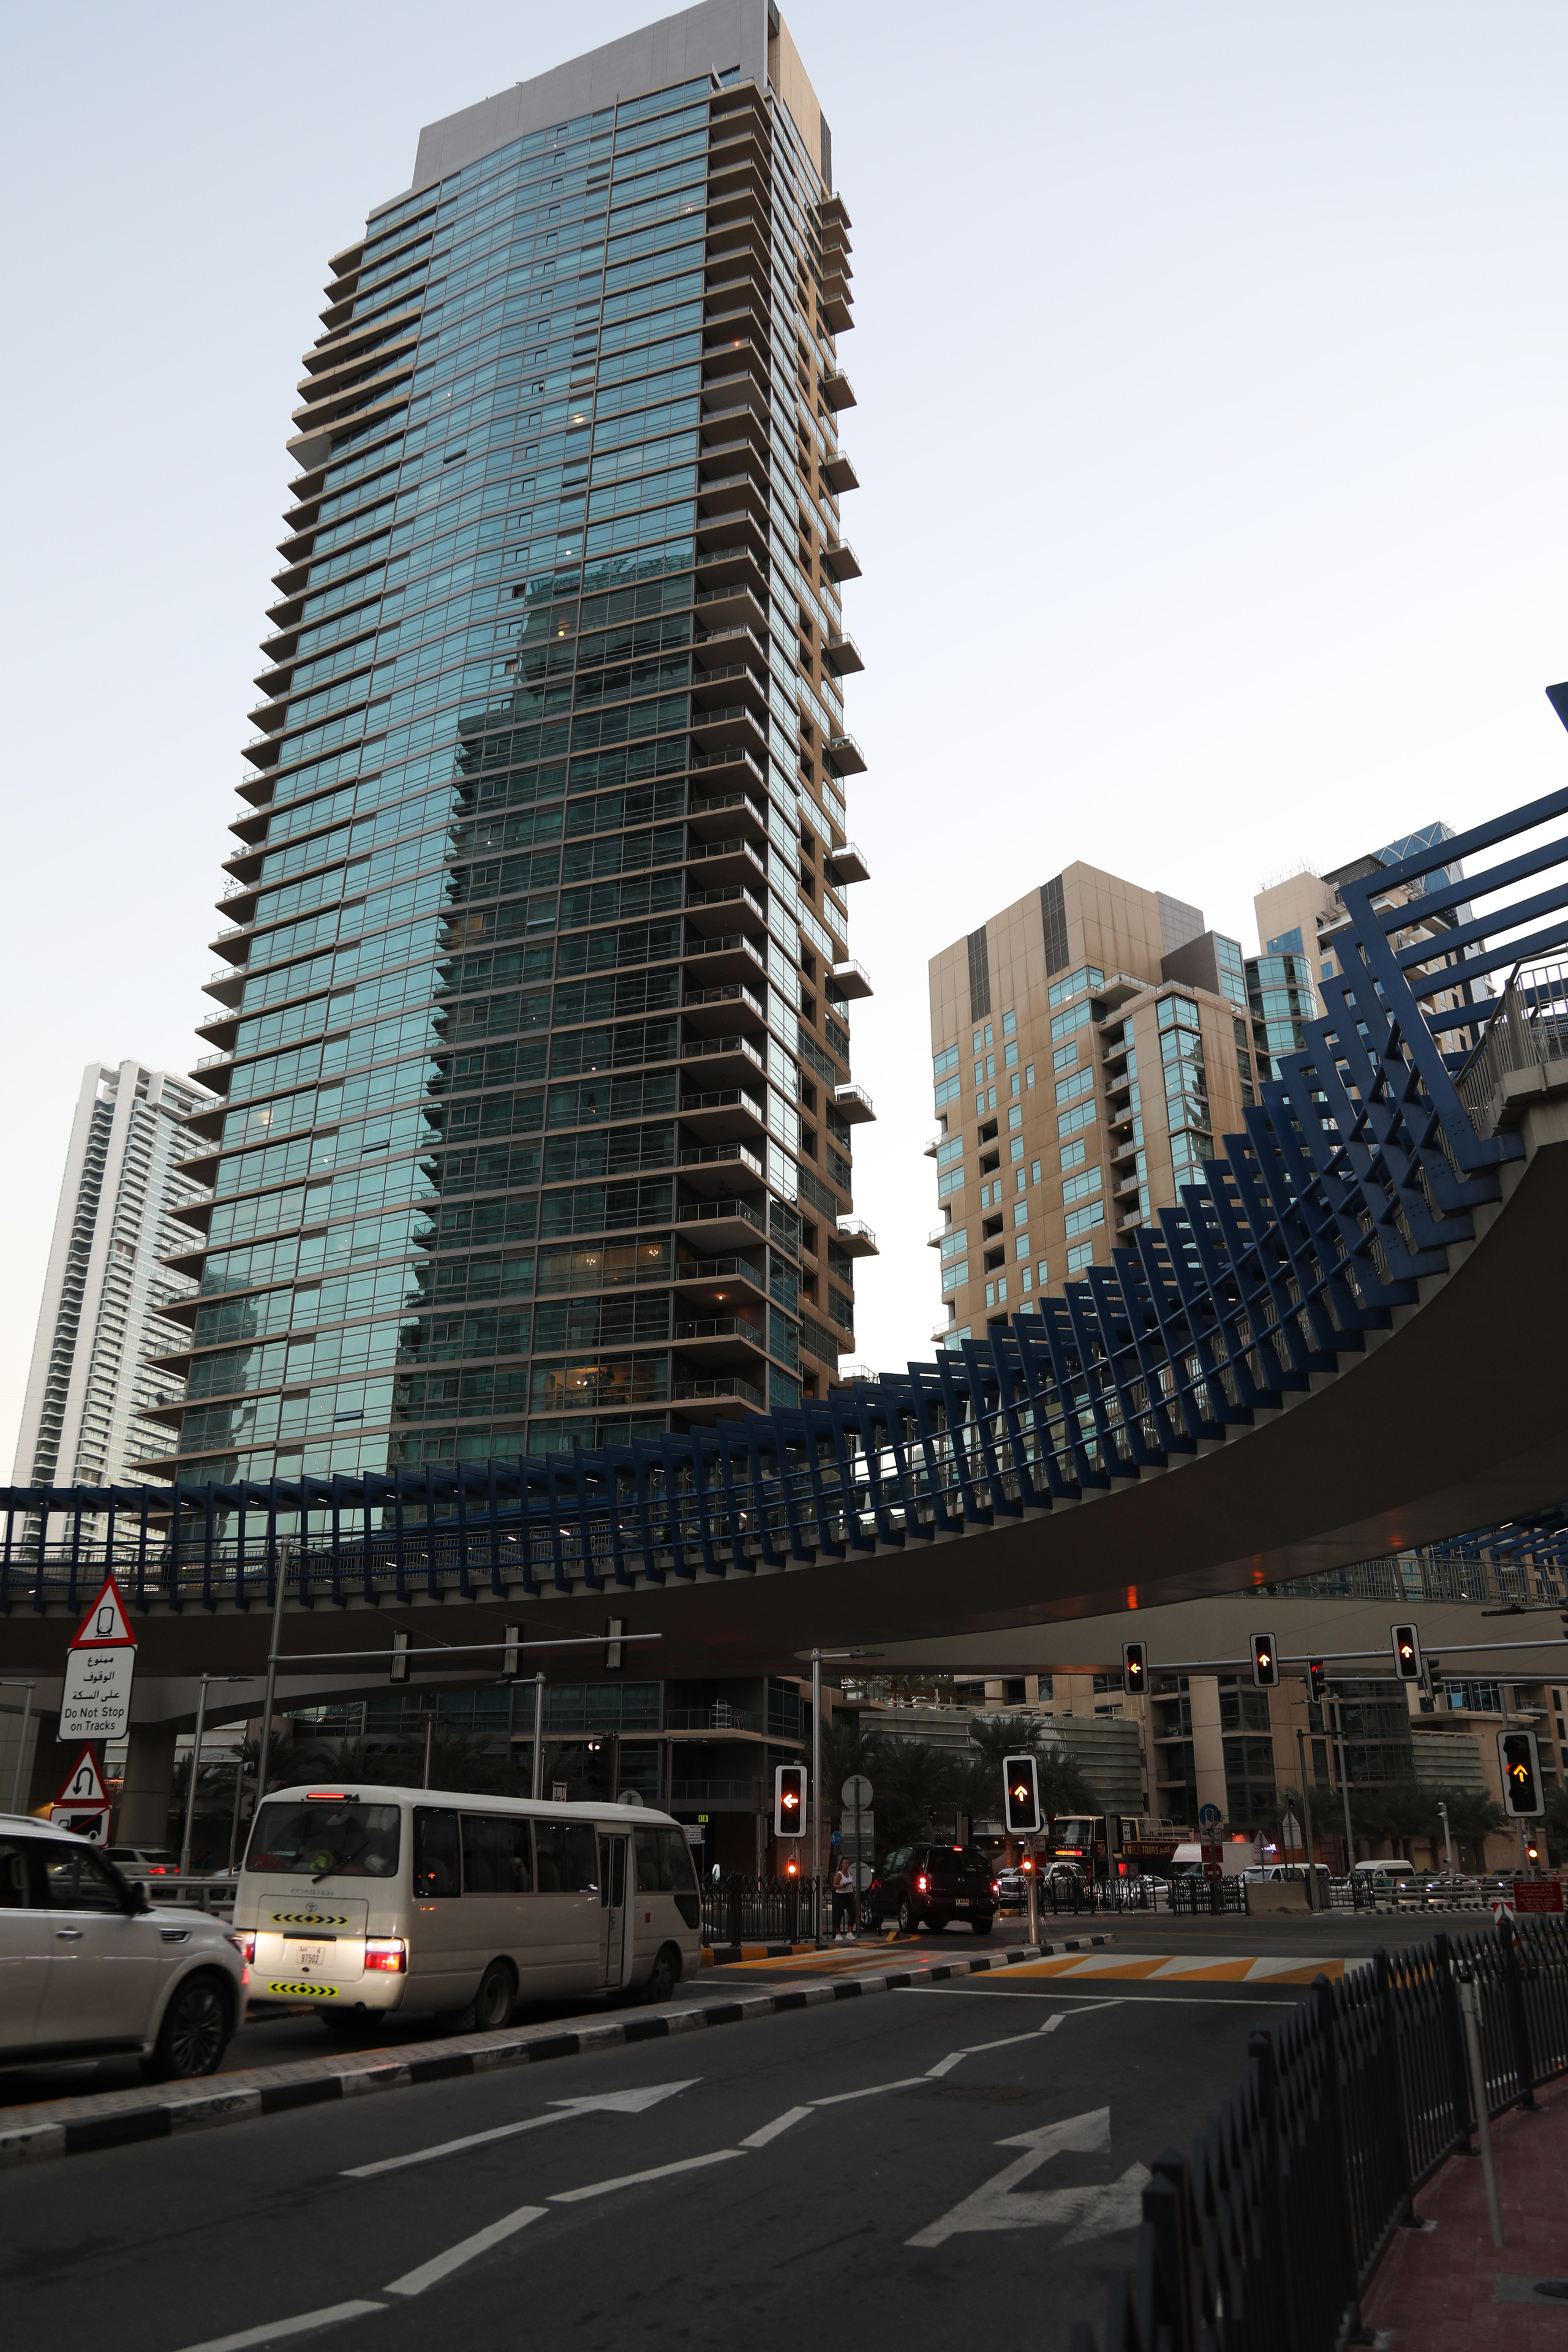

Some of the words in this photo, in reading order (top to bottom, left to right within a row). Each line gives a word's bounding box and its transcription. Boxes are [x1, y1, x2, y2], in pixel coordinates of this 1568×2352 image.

[87, 1656, 114, 1667] ممنوع
[84, 1671, 115, 1684] الوقوف
[72, 1690, 99, 1700] السكة
[101, 1689, 121, 1702] على
[65, 1708, 78, 1718] Do
[80, 1708, 98, 1717] Not
[102, 1706, 125, 1719] Stop
[70, 1723, 83, 1732] on
[86, 1720, 116, 1731] Tracks
[1142, 1845, 1159, 1855] TOURS
[301, 1954, 319, 1963] 97502
